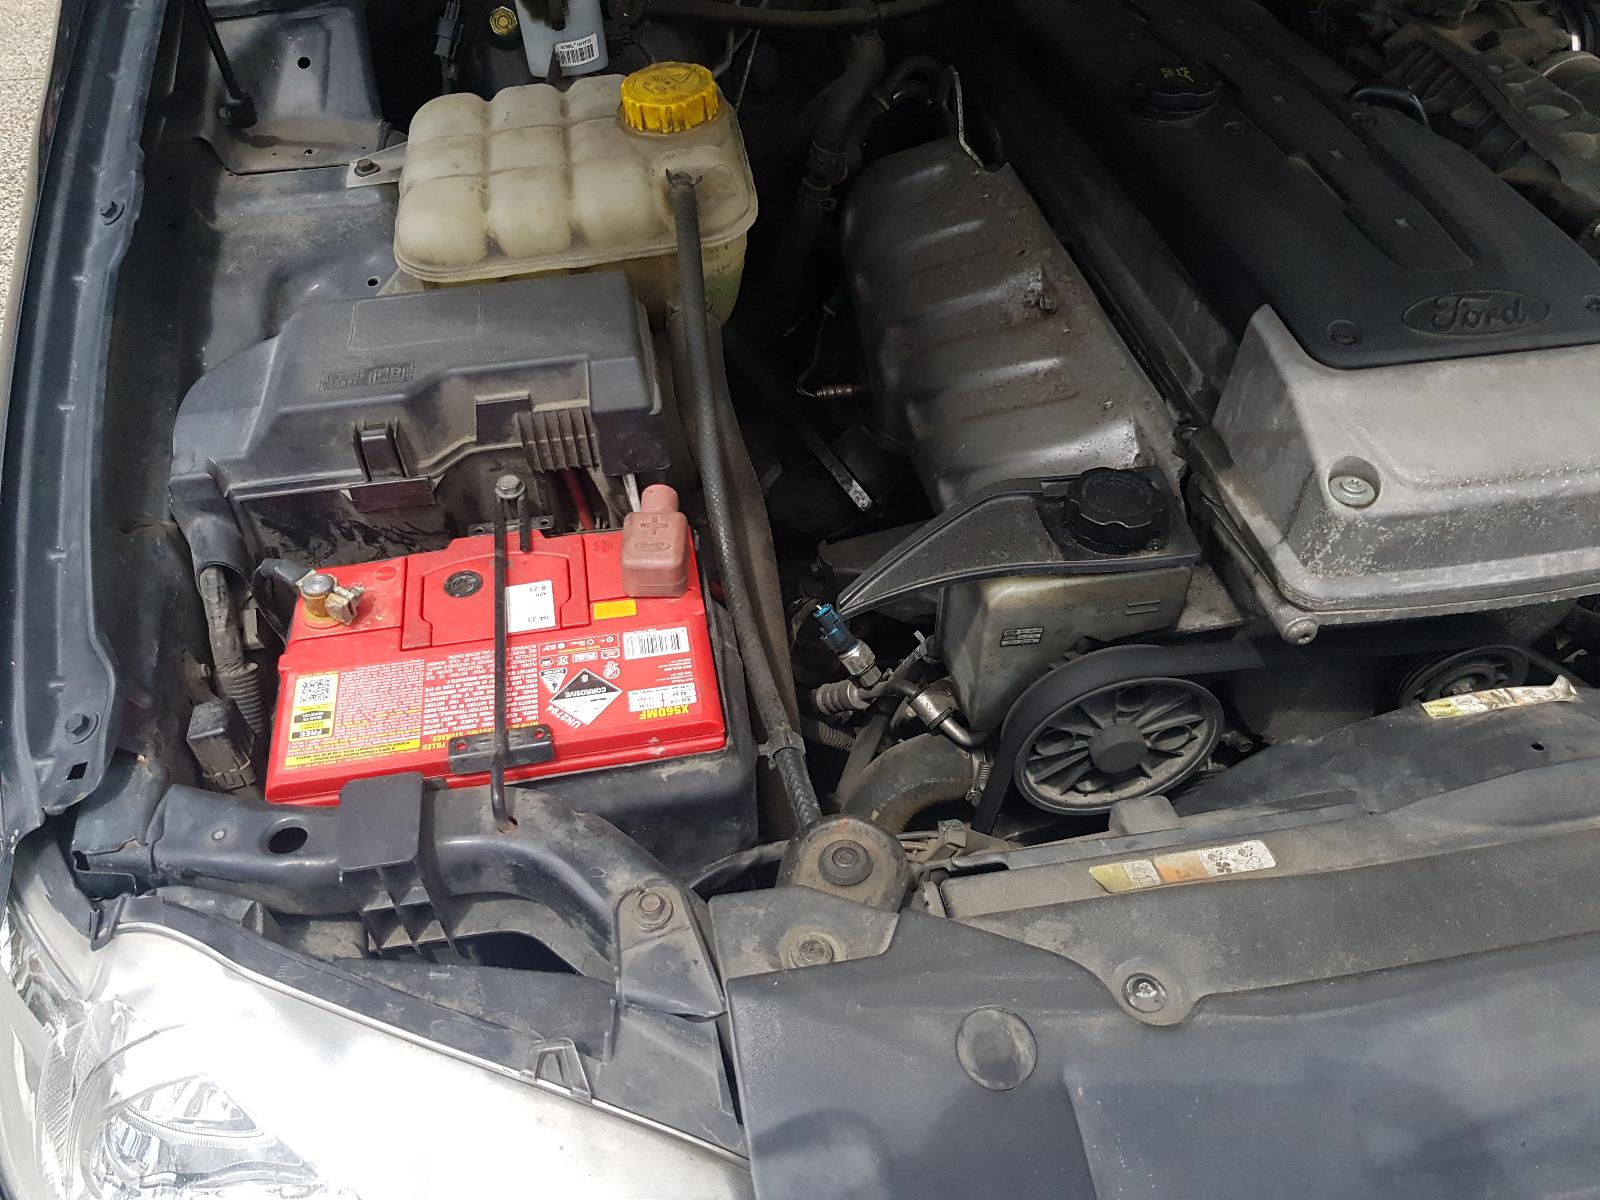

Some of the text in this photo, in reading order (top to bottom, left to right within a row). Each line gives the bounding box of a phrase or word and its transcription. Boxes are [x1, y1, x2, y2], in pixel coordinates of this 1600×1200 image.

[1430, 296, 1528, 333] Ford
[581, 673, 588, 682] 8
[564, 685, 606, 698] CORROSIVE
[546, 703, 581, 729] UN2794
[638, 703, 689, 720] X56DMF
[299, 728, 322, 737] FREE
[422, 741, 445, 751] FILLED
